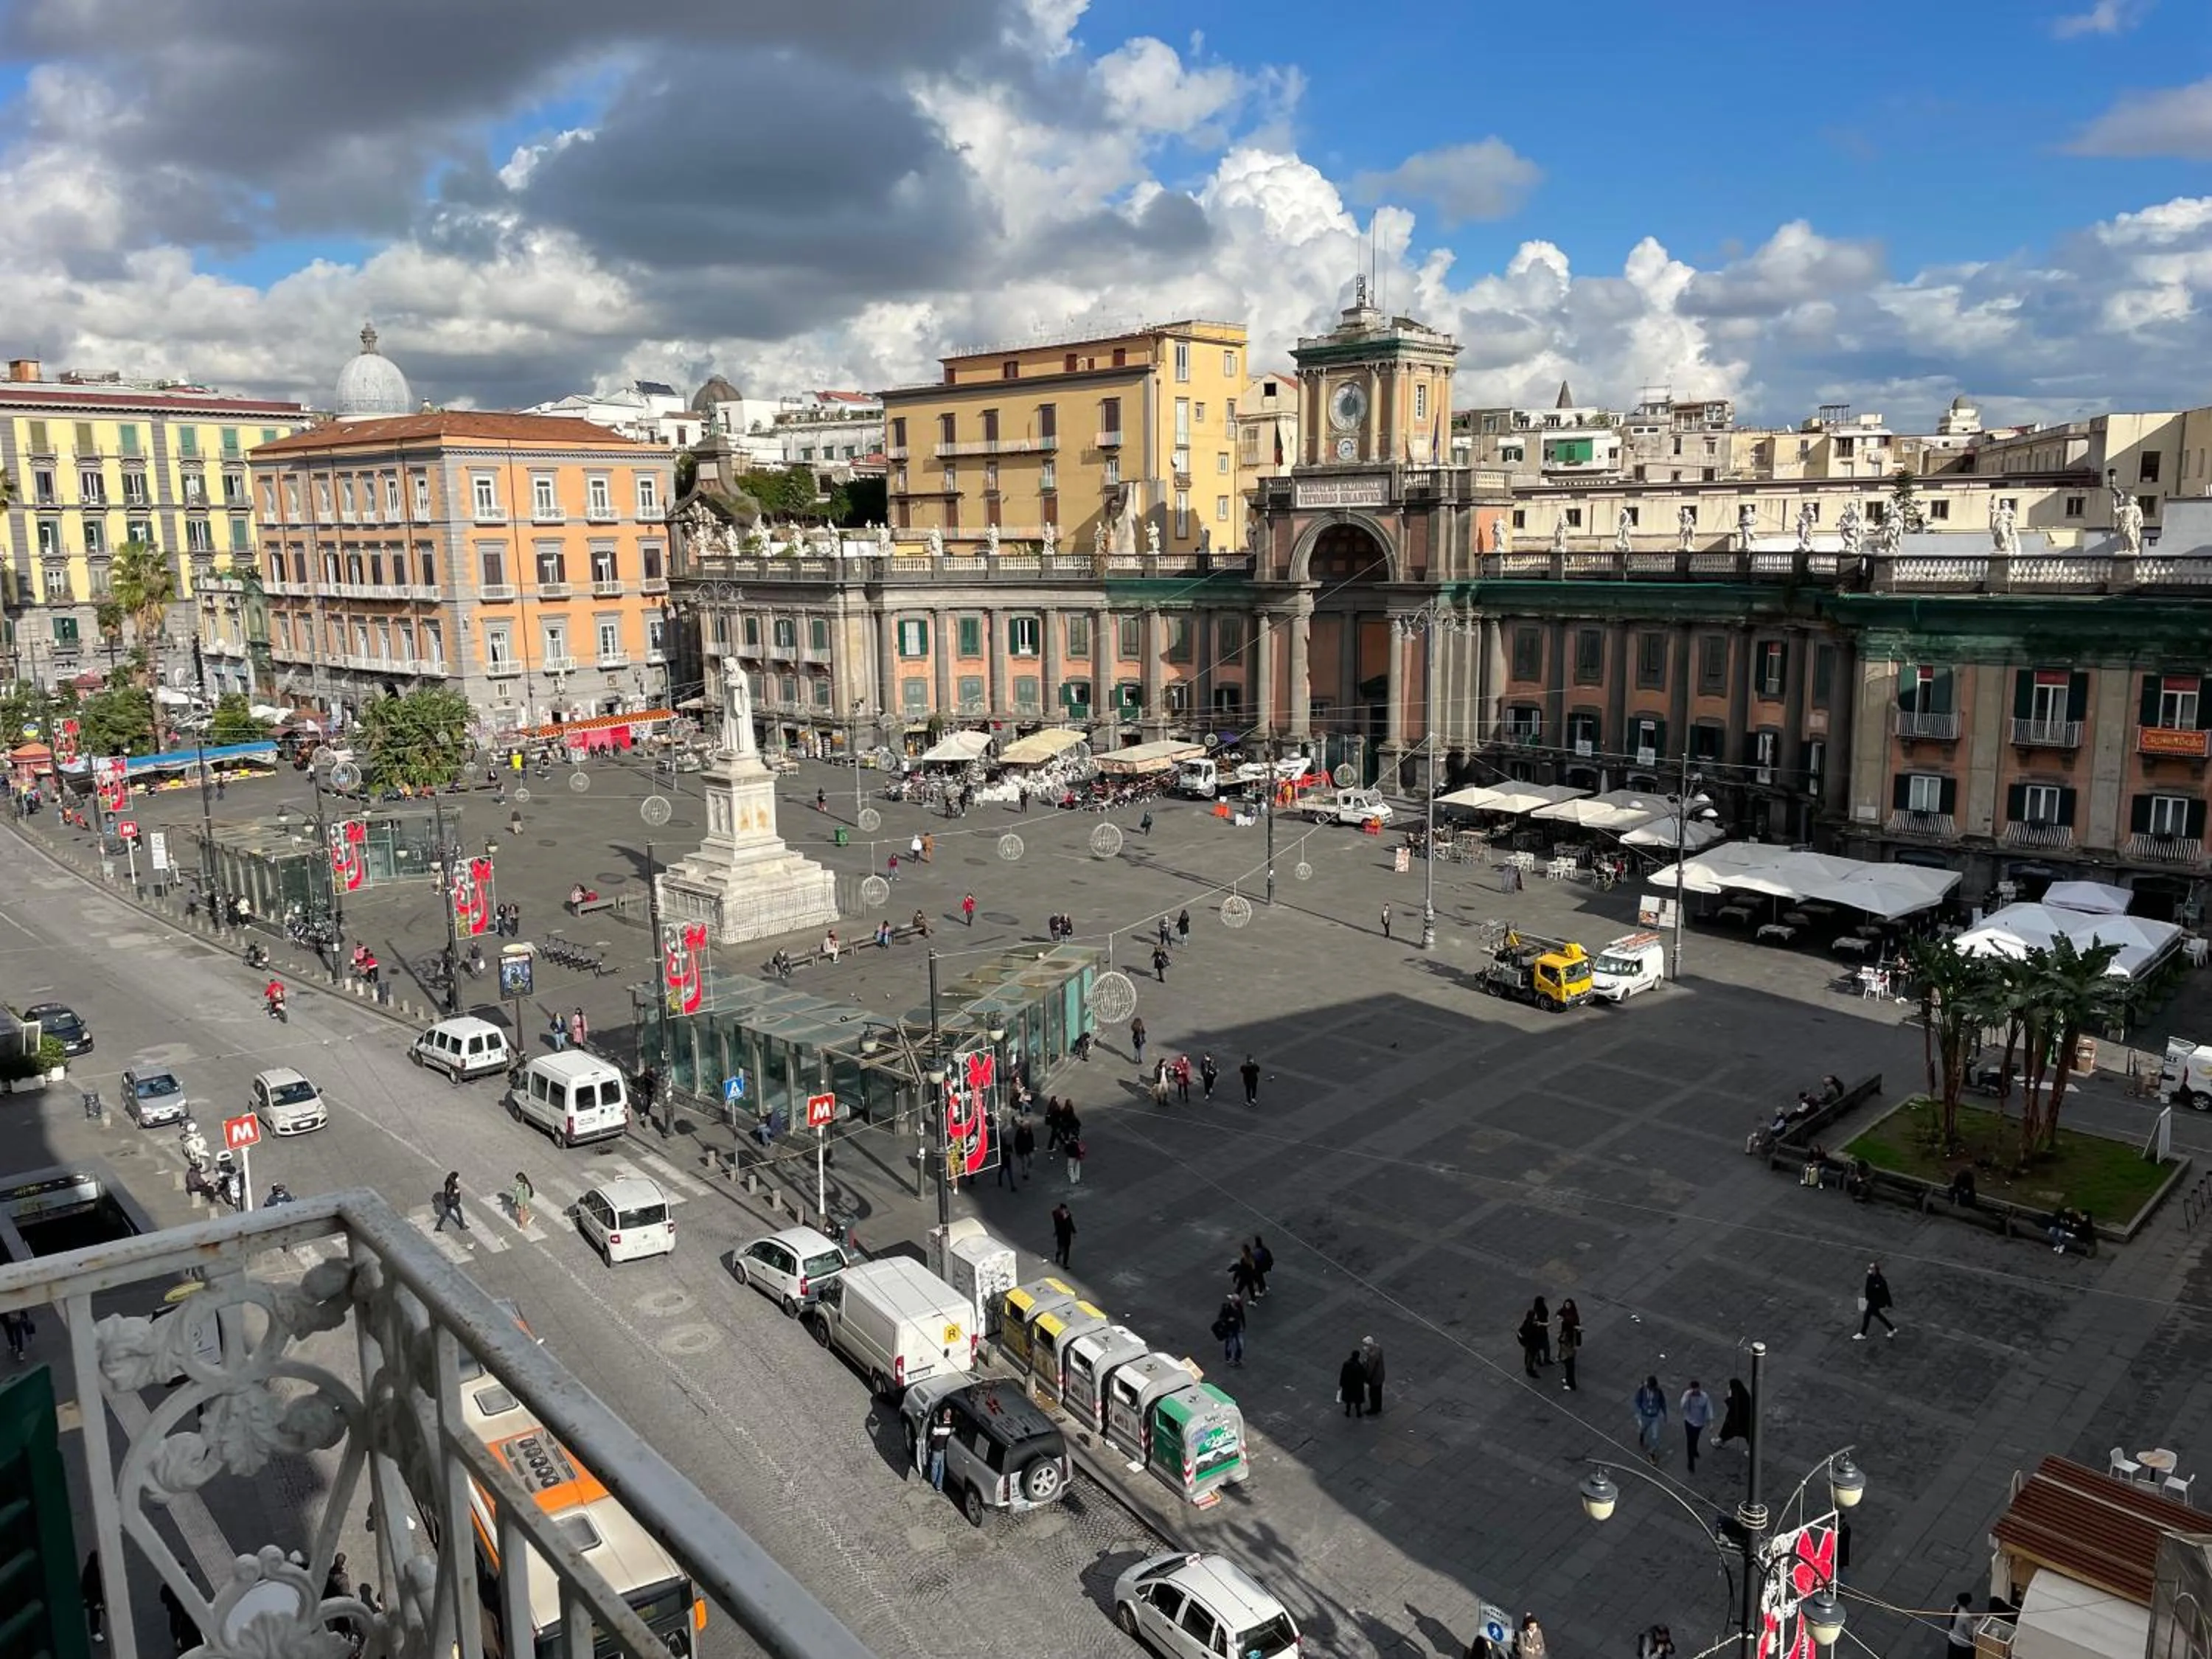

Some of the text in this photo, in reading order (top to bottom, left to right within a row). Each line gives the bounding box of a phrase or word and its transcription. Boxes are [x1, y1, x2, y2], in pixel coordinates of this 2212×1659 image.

[123, 824, 134, 834] M
[813, 1101, 831, 1120] M
[232, 1121, 254, 1144] M
